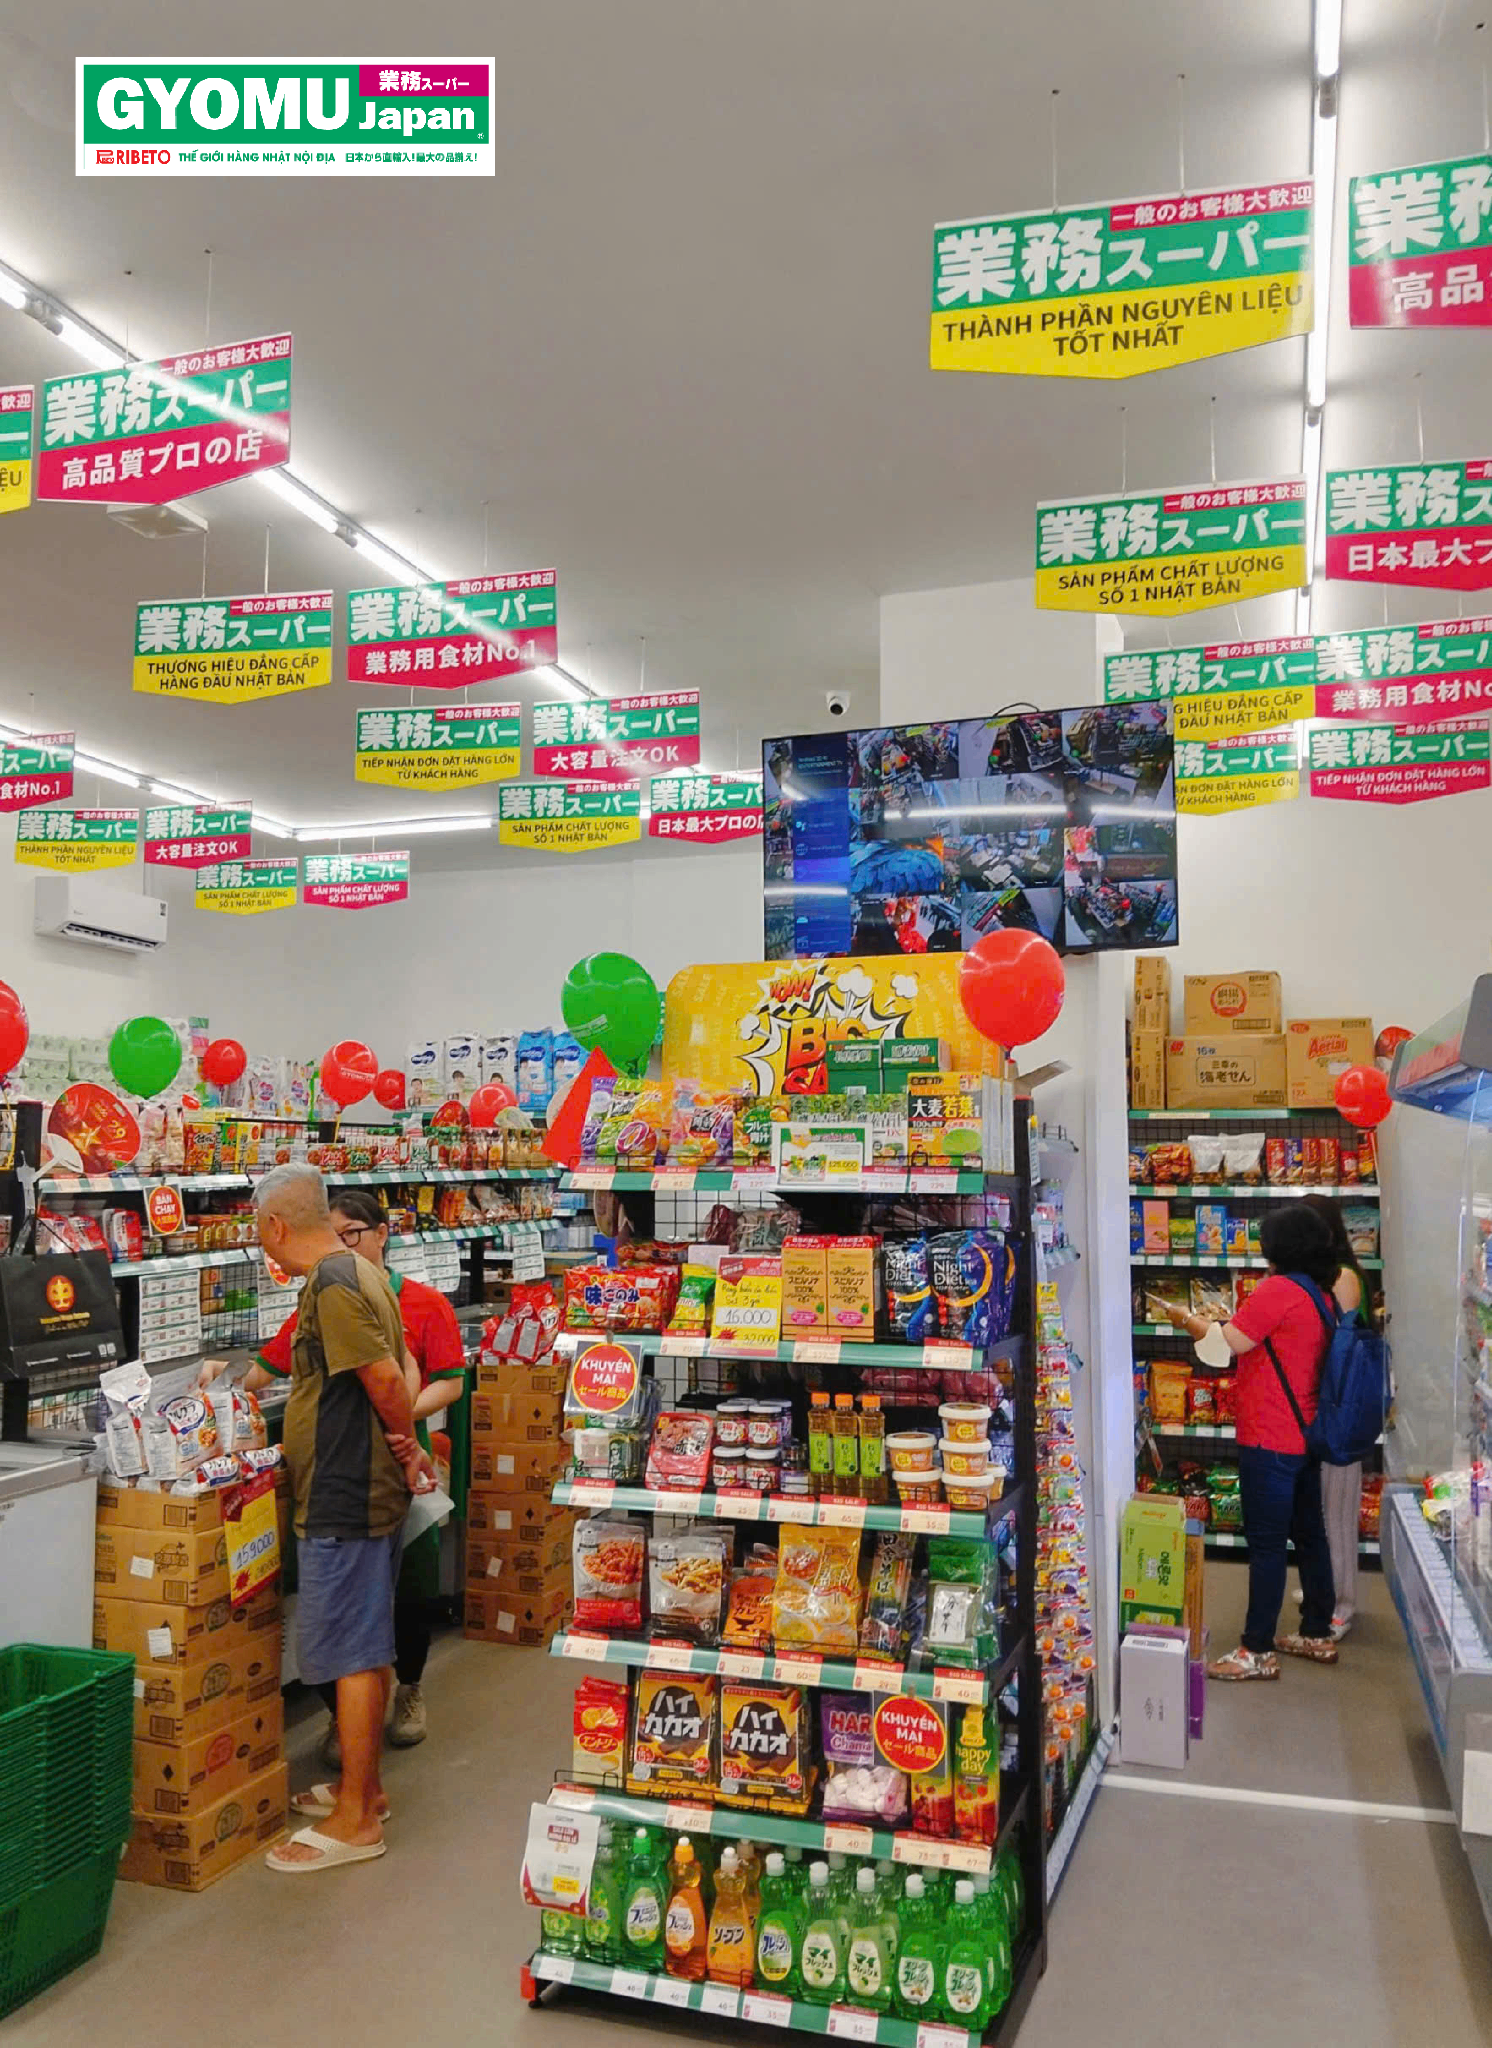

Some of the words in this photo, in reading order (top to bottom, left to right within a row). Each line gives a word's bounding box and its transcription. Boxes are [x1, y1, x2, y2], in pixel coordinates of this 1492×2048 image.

[1112, 185, 1312, 225] 一般のお客様大歓迎
[936, 215, 1312, 304] 業務スーパー
[943, 314, 1032, 342] THÀNH
[1041, 303, 1113, 331] PHẦN
[1122, 291, 1233, 322] NGUYÊN
[1242, 283, 1303, 314] LIỆU
[1053, 329, 1105, 356] TỐT
[1112, 320, 1184, 351] NHẤT
[44, 369, 287, 446] 業務スーパー
[62, 430, 265, 490] 高品質プロの店
[1040, 503, 1305, 566] 業務スーパー
[447, 572, 555, 594] 一般のお客様大歓迎
[1059, 571, 1095, 590] SẢN
[1101, 564, 1154, 586] PHẨM
[1160, 559, 1209, 580] CHẤT
[1215, 555, 1284, 579] LƯỢNG
[1098, 588, 1124, 605] SỐ
[1129, 590, 1139, 602] 1
[1145, 583, 1196, 602] NHẬT
[1202, 578, 1241, 596] BẢN
[350, 588, 554, 642] 業務スーパー
[137, 605, 331, 653] 業務スーパー
[147, 659, 207, 674] THƯƠNG
[249, 654, 288, 670] ĐẲNG
[291, 652, 319, 668] CẤP
[365, 639, 535, 675] 業務用食材No.1
[160, 676, 199, 690] HÀNG
[202, 674, 231, 688] ĐẦU
[235, 673, 273, 690] NHẬT
[276, 669, 305, 685] BẢN
[1107, 652, 1314, 700] 業務スーパー
[1273, 691, 1304, 706] CẤP
[359, 712, 519, 751] 業務スーパー
[533, 703, 698, 745] 業務スーパー
[362, 758, 384, 768] TIẾP
[463, 756, 492, 765] HÀNG
[494, 754, 515, 764] LỚN
[551, 745, 679, 772] 大容量注文OK
[1310, 728, 1489, 768] 業務スーパー
[397, 770, 412, 780] TỪ
[413, 769, 447, 779] KHÁCH
[450, 768, 479, 778] HÀNG
[502, 787, 640, 819] 業務スーパー
[18, 811, 137, 840] 業務スーパー
[145, 809, 251, 839] 業務スーパー
[156, 840, 238, 860] 大容量注文OK
[197, 864, 296, 889] 業務スーパー
[305, 858, 408, 883] 業務スーパー
[912, 1095, 975, 1118] 大麦若葉
[933, 1260, 974, 1273] Night
[933, 1272, 964, 1286] Diet
[578, 1385, 627, 1400] セール商品
[652, 1690, 694, 1714] ハイ
[644, 1712, 703, 1739] カカオ
[738, 1705, 778, 1730] ハイ
[729, 1728, 790, 1756] カカオ
[883, 1738, 938, 1761] セール商品
[955, 1746, 992, 1764] happy
[960, 1758, 987, 1775] day
